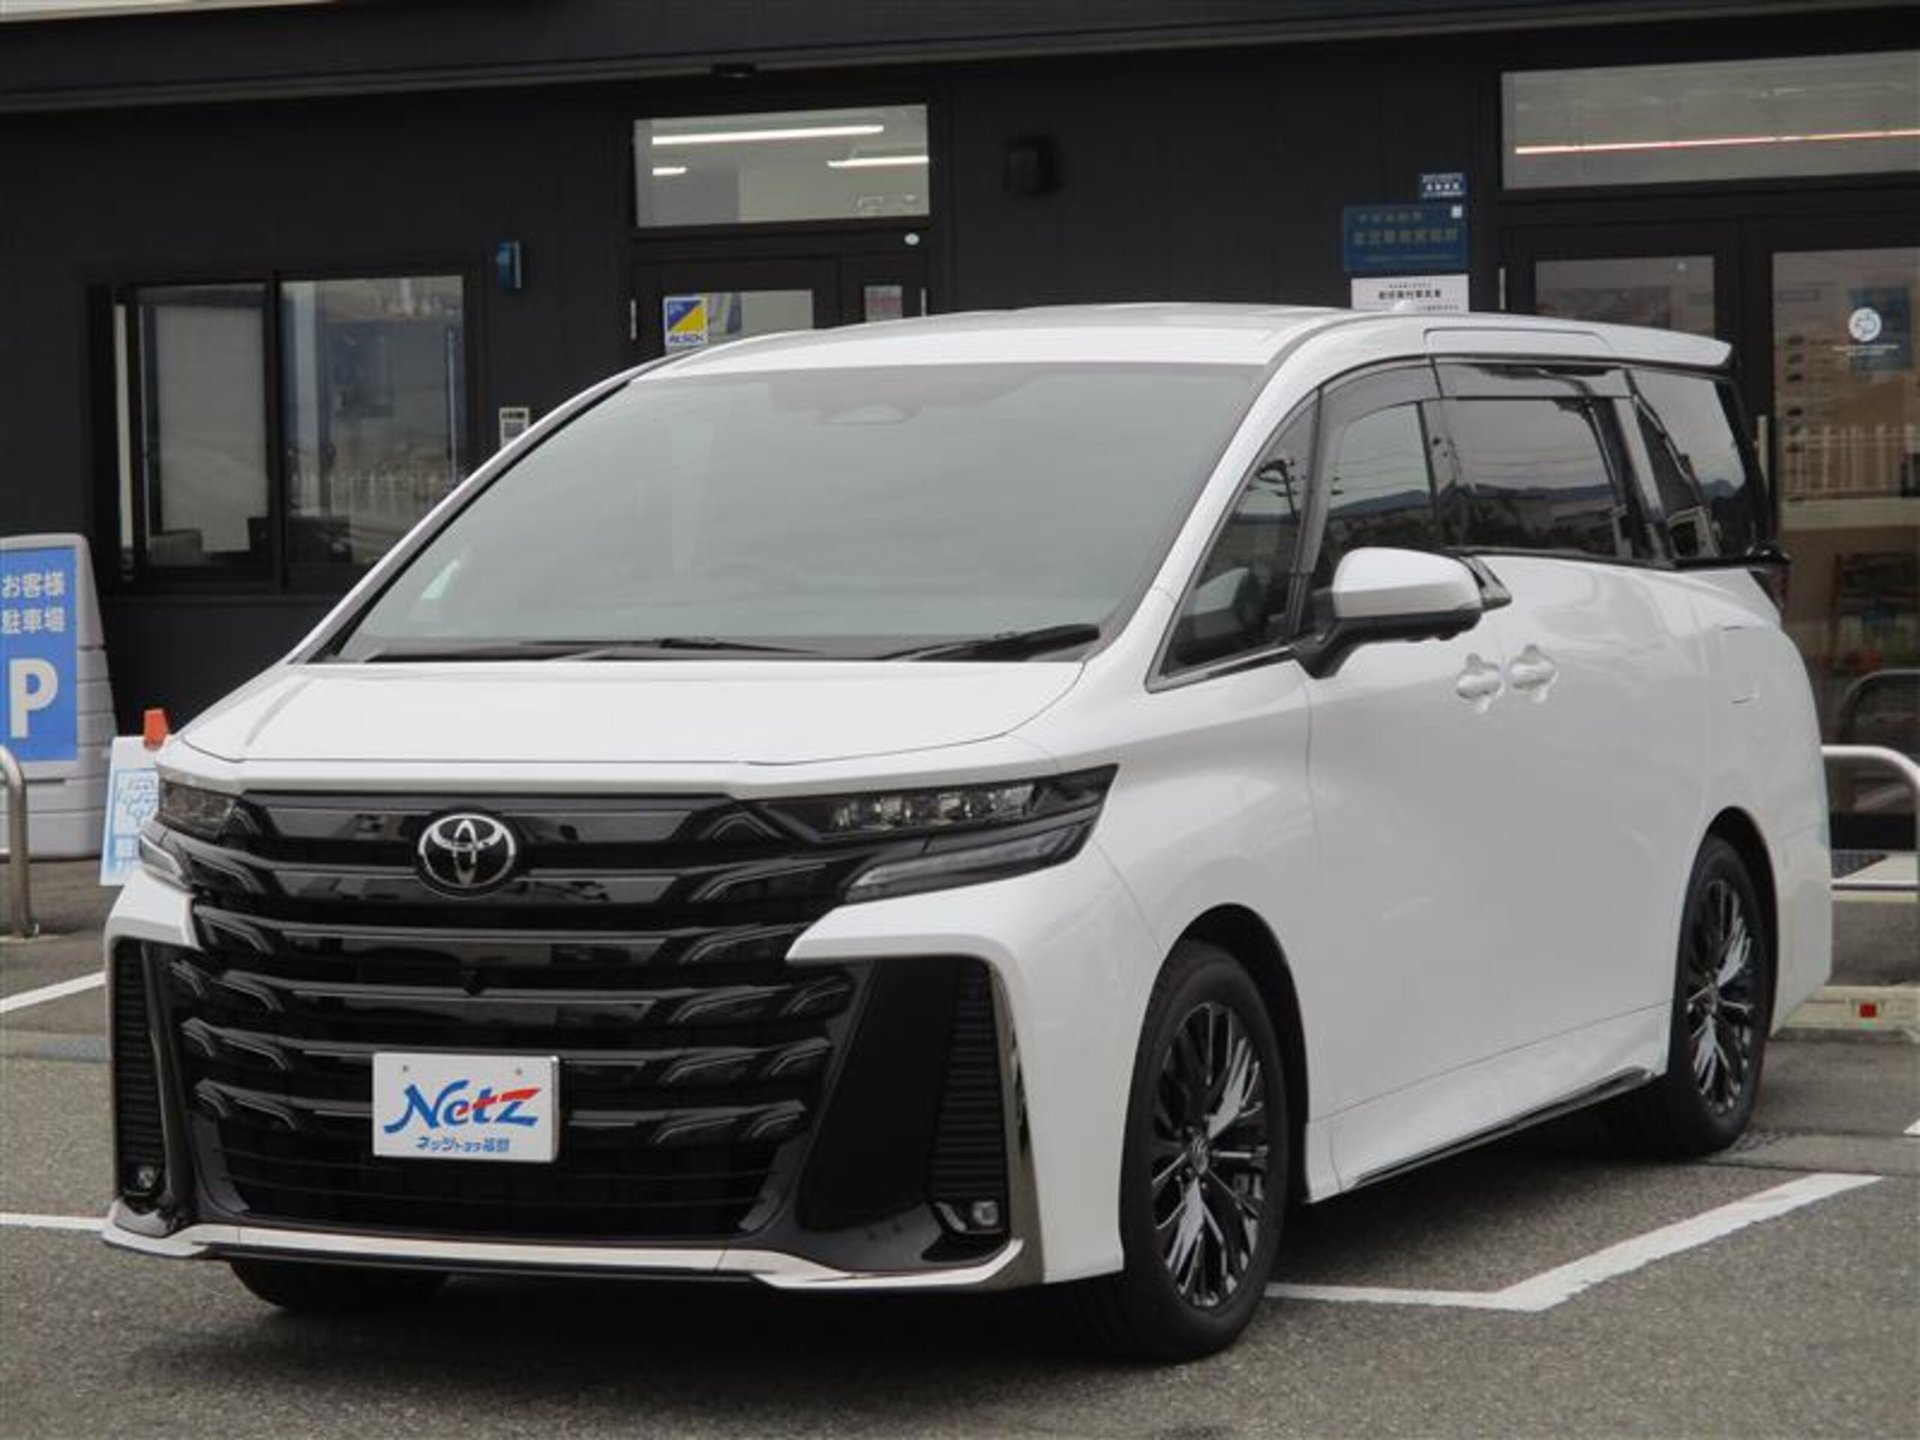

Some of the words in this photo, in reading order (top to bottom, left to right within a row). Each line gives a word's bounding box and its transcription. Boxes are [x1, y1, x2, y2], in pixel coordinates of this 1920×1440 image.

[2, 572, 65, 599] お客様
[2, 607, 65, 634] 駐車場
[9, 658, 58, 738] P
[383, 1079, 541, 1133] Netz
